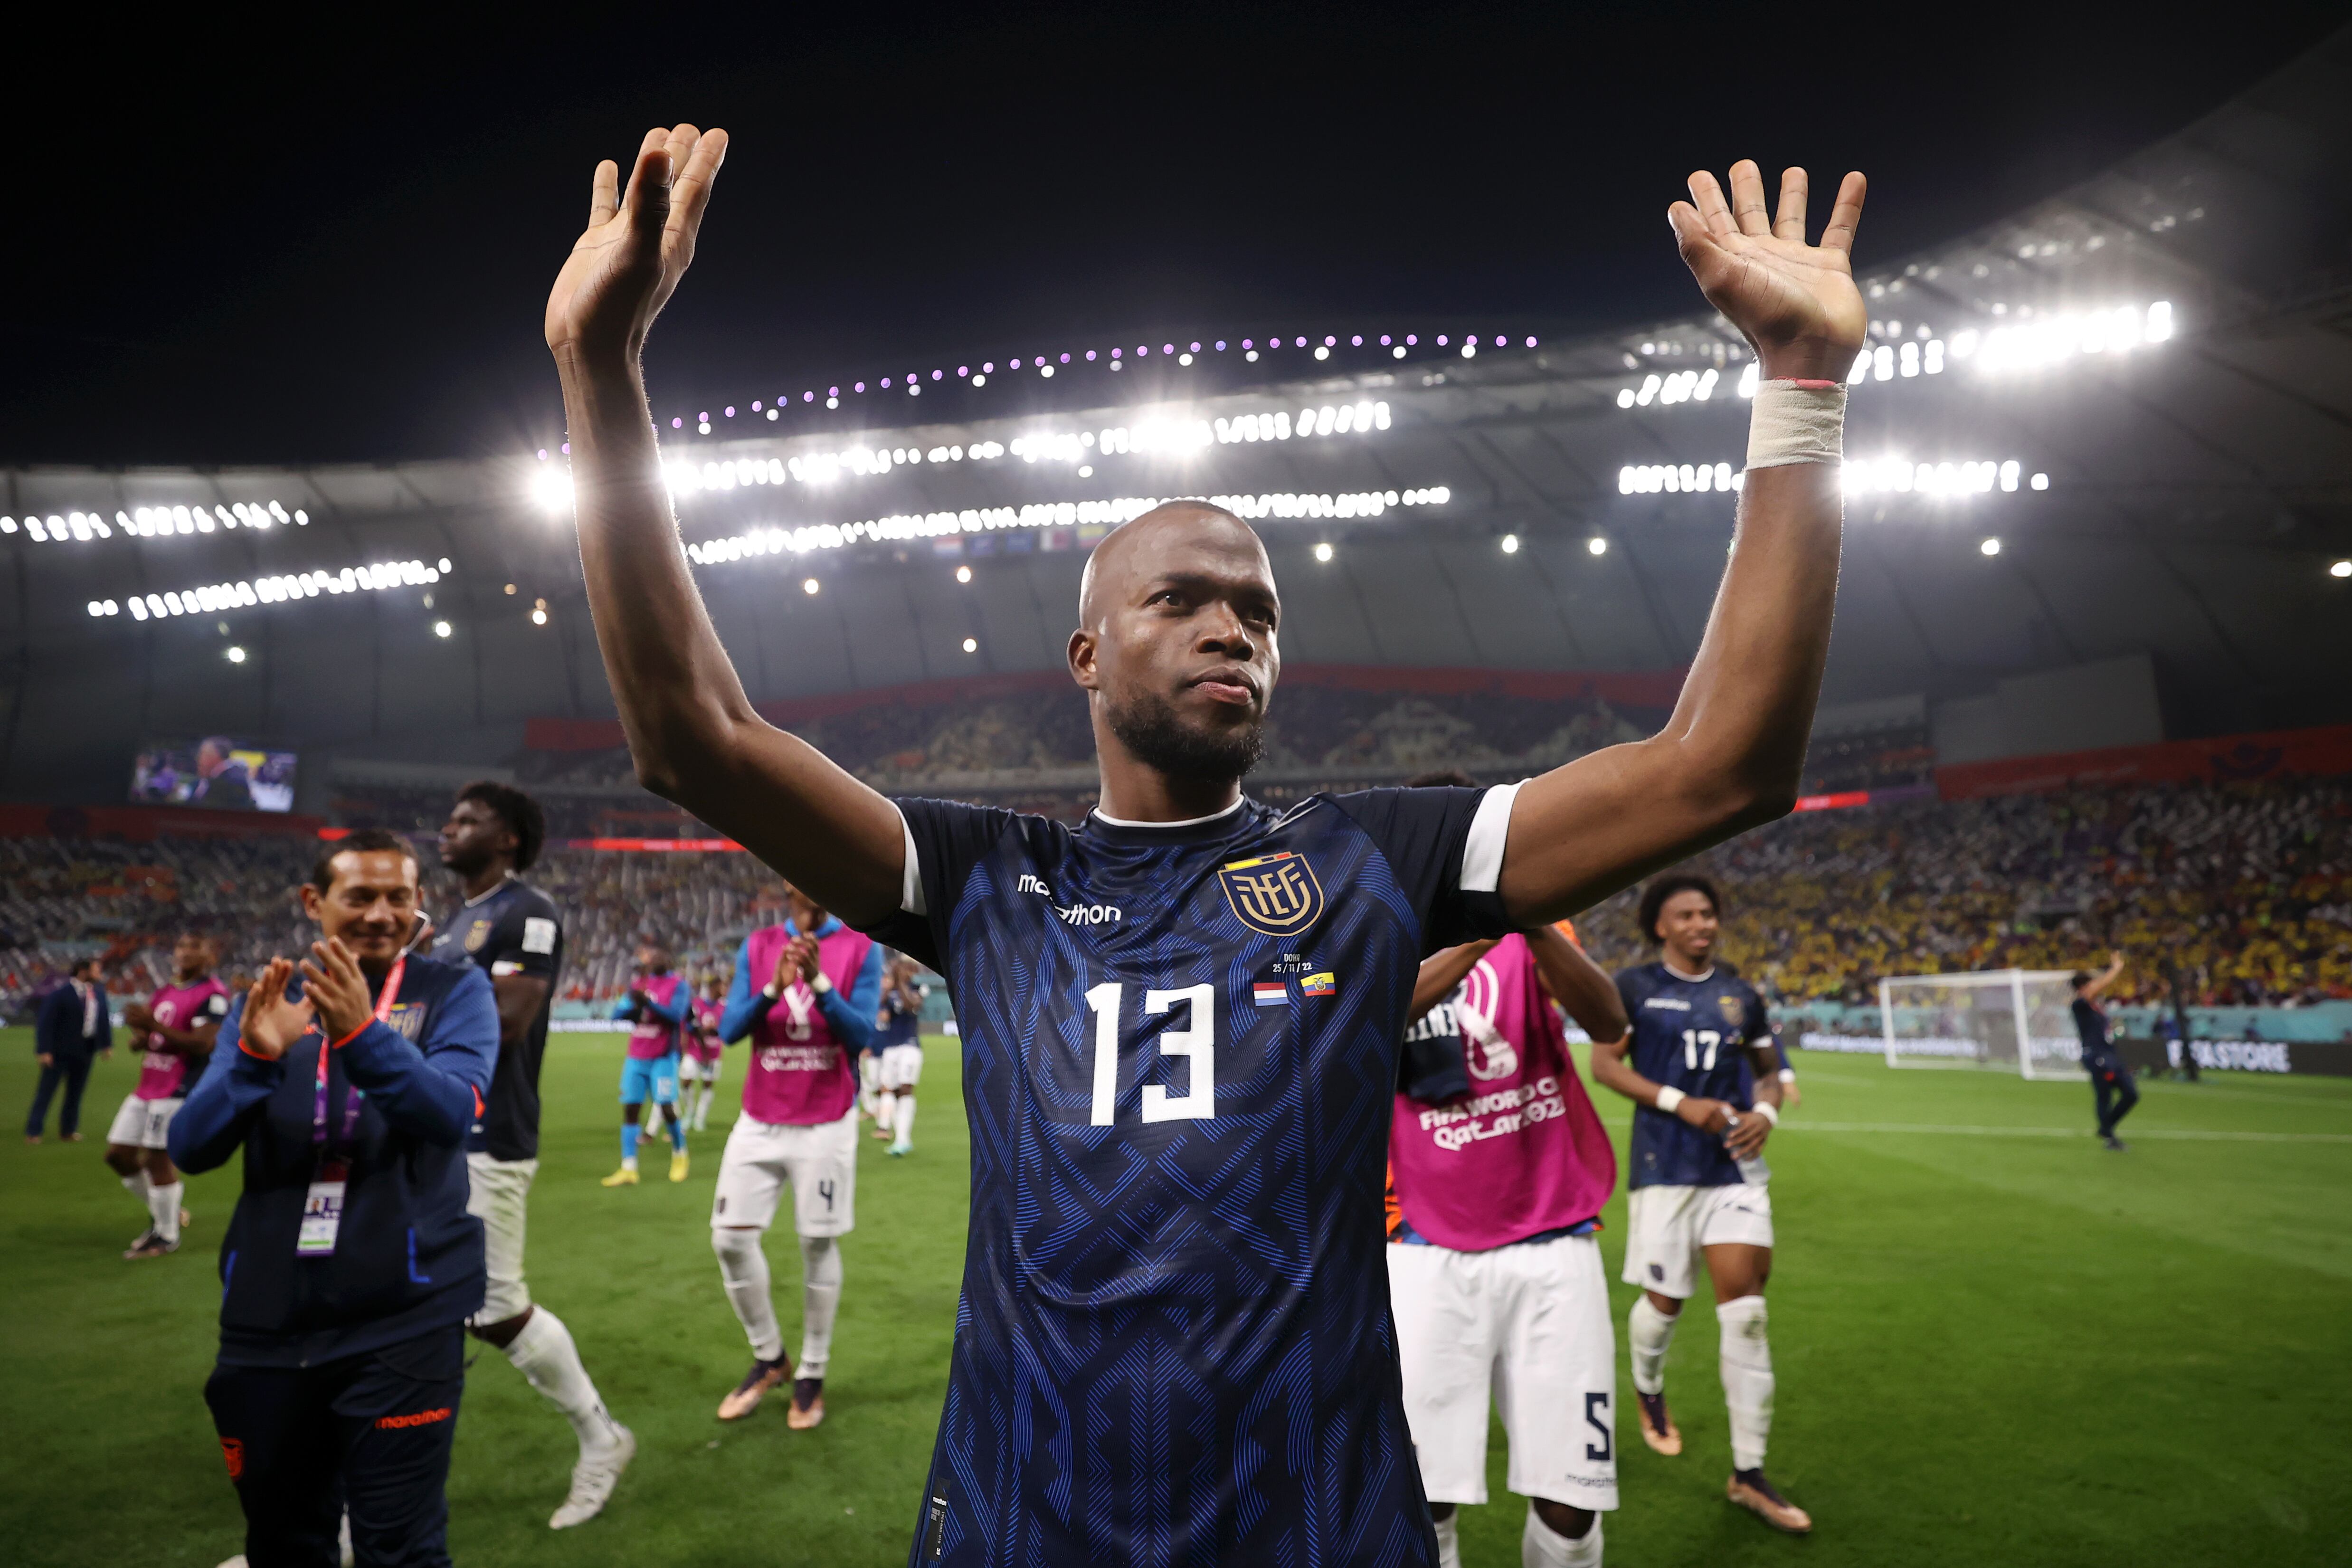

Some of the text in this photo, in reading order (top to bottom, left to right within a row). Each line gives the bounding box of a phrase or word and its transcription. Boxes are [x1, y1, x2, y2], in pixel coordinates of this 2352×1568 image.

[1017, 874, 1122, 926] maathon
[1284, 953, 1300, 962] DOHA
[1084, 981, 1215, 1126] 13
[1681, 1028, 1721, 1071] 17
[1432, 1112, 1522, 1152] Qatar
[819, 1180, 835, 1213] 4
[1585, 1392, 1610, 1461] 5
